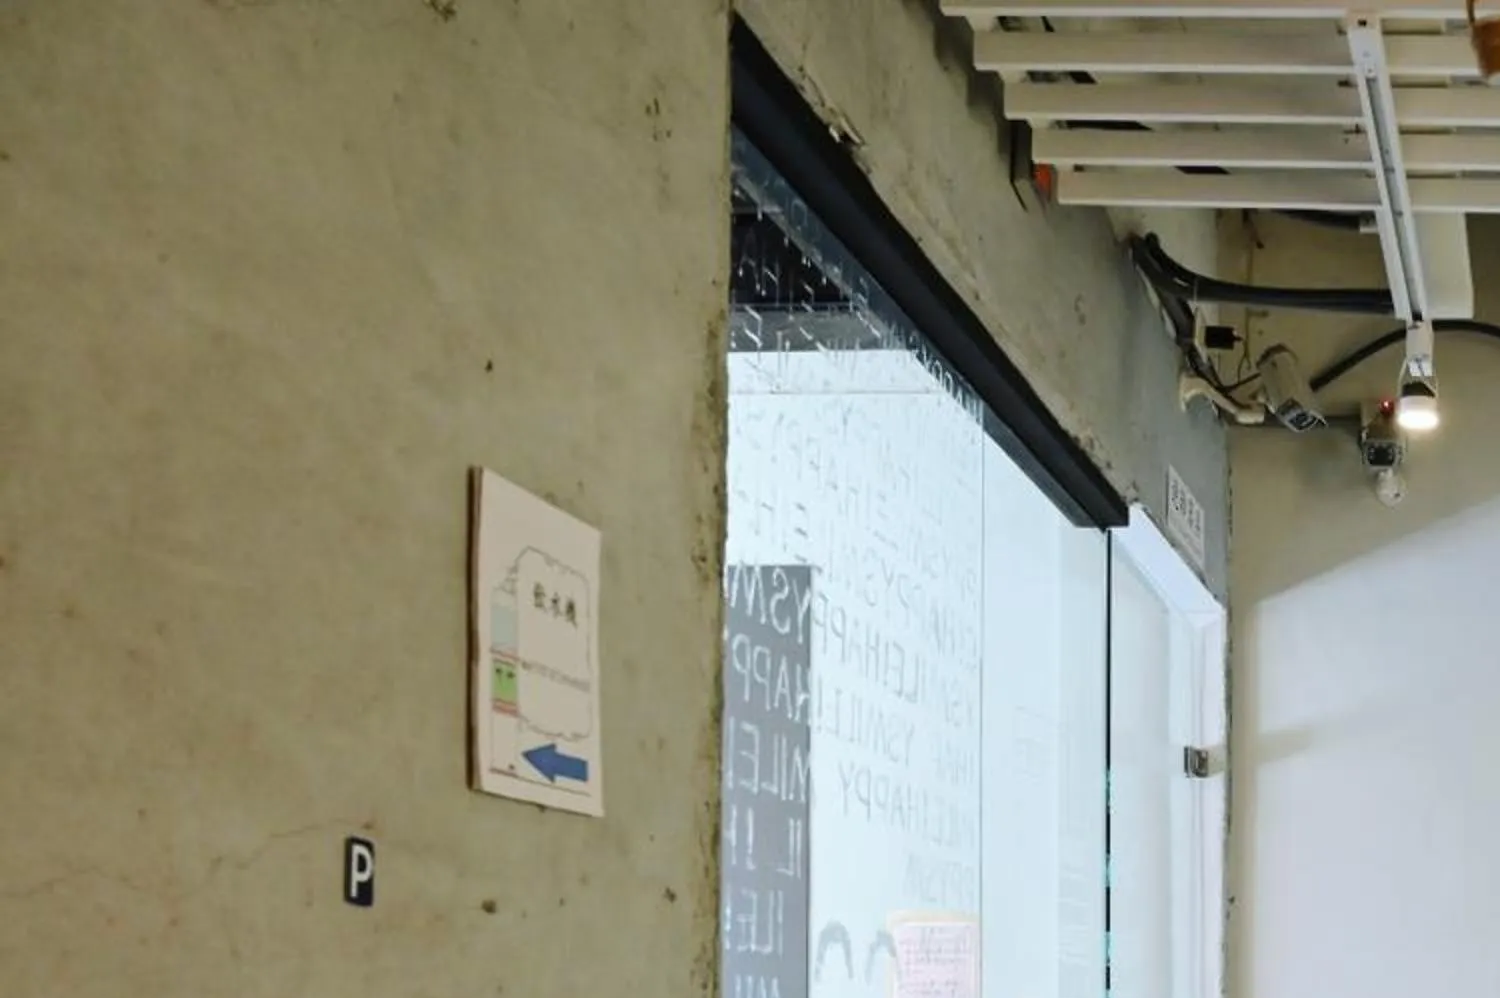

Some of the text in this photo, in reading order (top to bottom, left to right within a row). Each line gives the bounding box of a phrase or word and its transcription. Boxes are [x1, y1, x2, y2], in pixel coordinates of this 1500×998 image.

[532, 581, 578, 629] 飲水機
[350, 844, 373, 898] P
